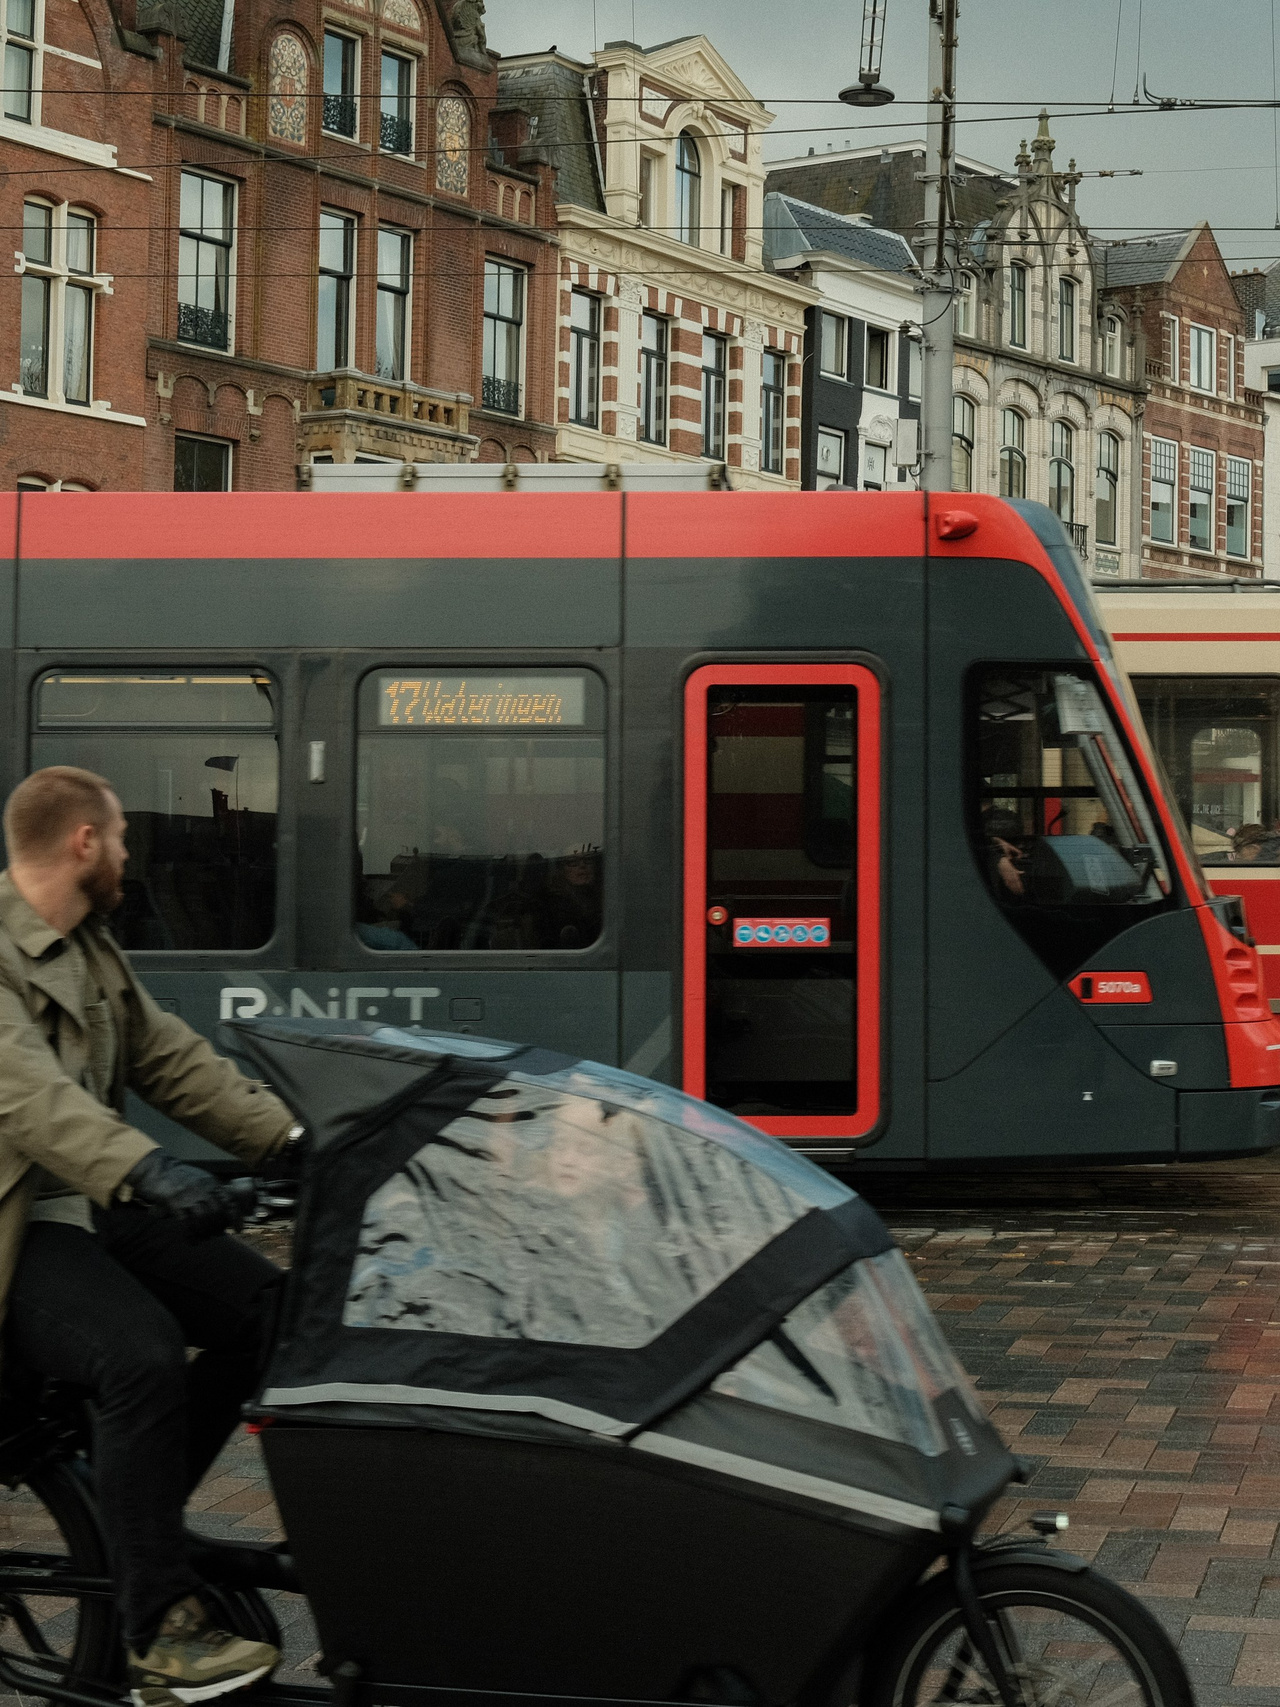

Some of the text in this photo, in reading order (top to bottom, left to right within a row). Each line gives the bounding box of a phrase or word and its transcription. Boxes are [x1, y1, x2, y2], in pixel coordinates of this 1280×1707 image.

[385, 681, 562, 723] 17 Wateringen
[1098, 981, 1142, 994] 5070a
